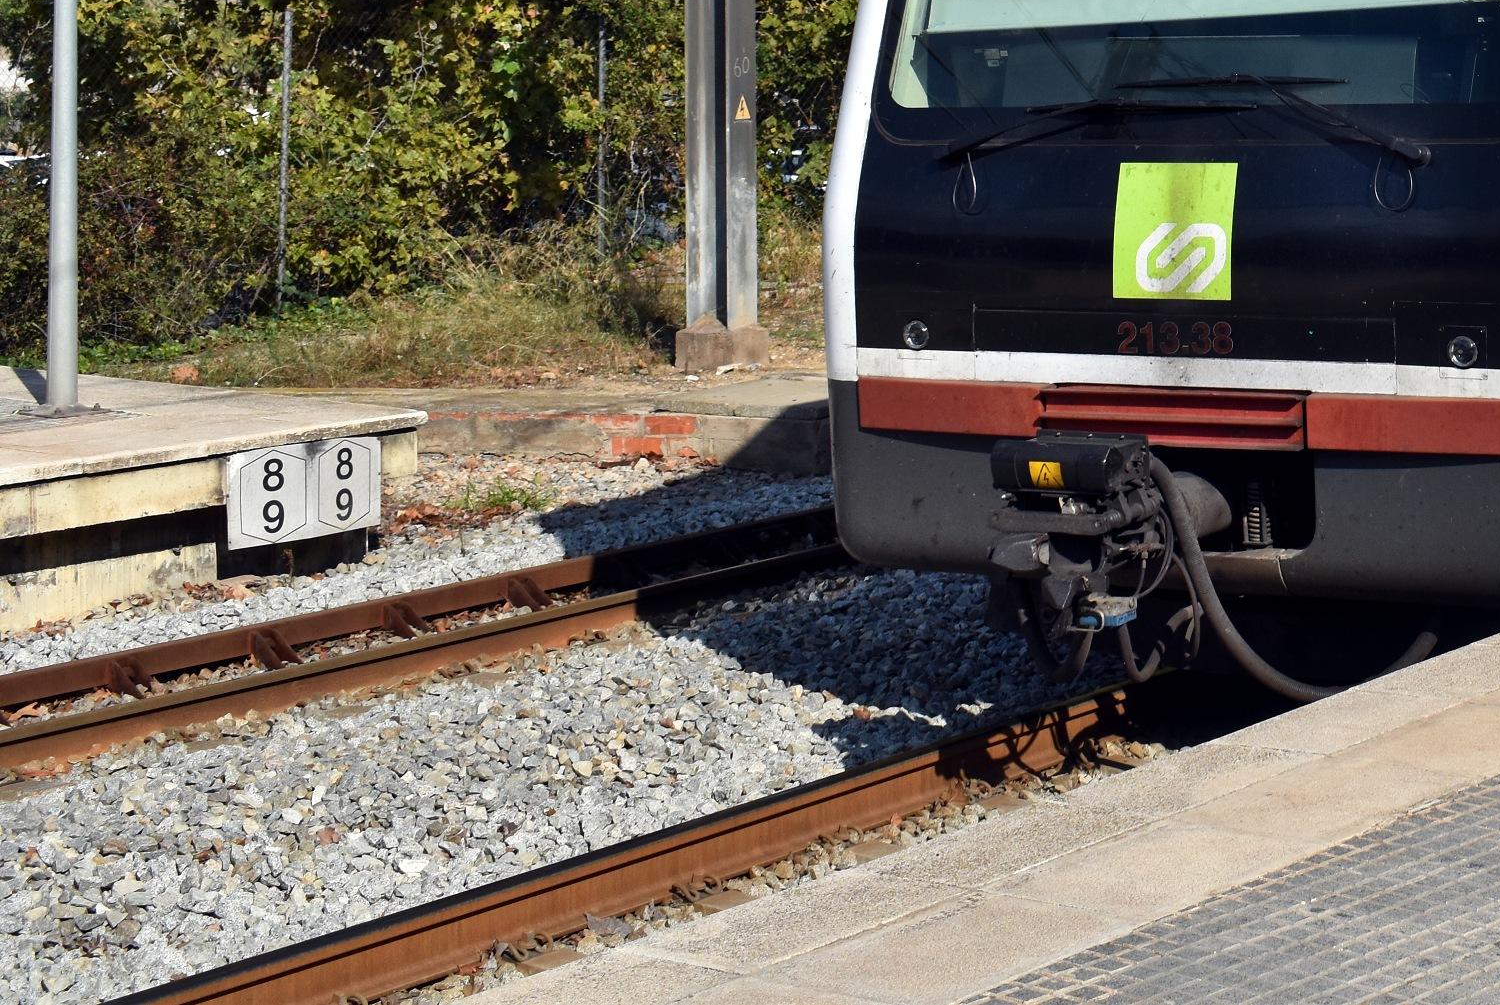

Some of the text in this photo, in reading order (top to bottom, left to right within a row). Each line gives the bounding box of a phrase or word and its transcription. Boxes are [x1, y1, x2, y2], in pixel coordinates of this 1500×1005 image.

[262, 458, 285, 492] 8
[336, 447, 354, 480] 8
[262, 499, 285, 534] 9
[336, 488, 354, 521] 9
